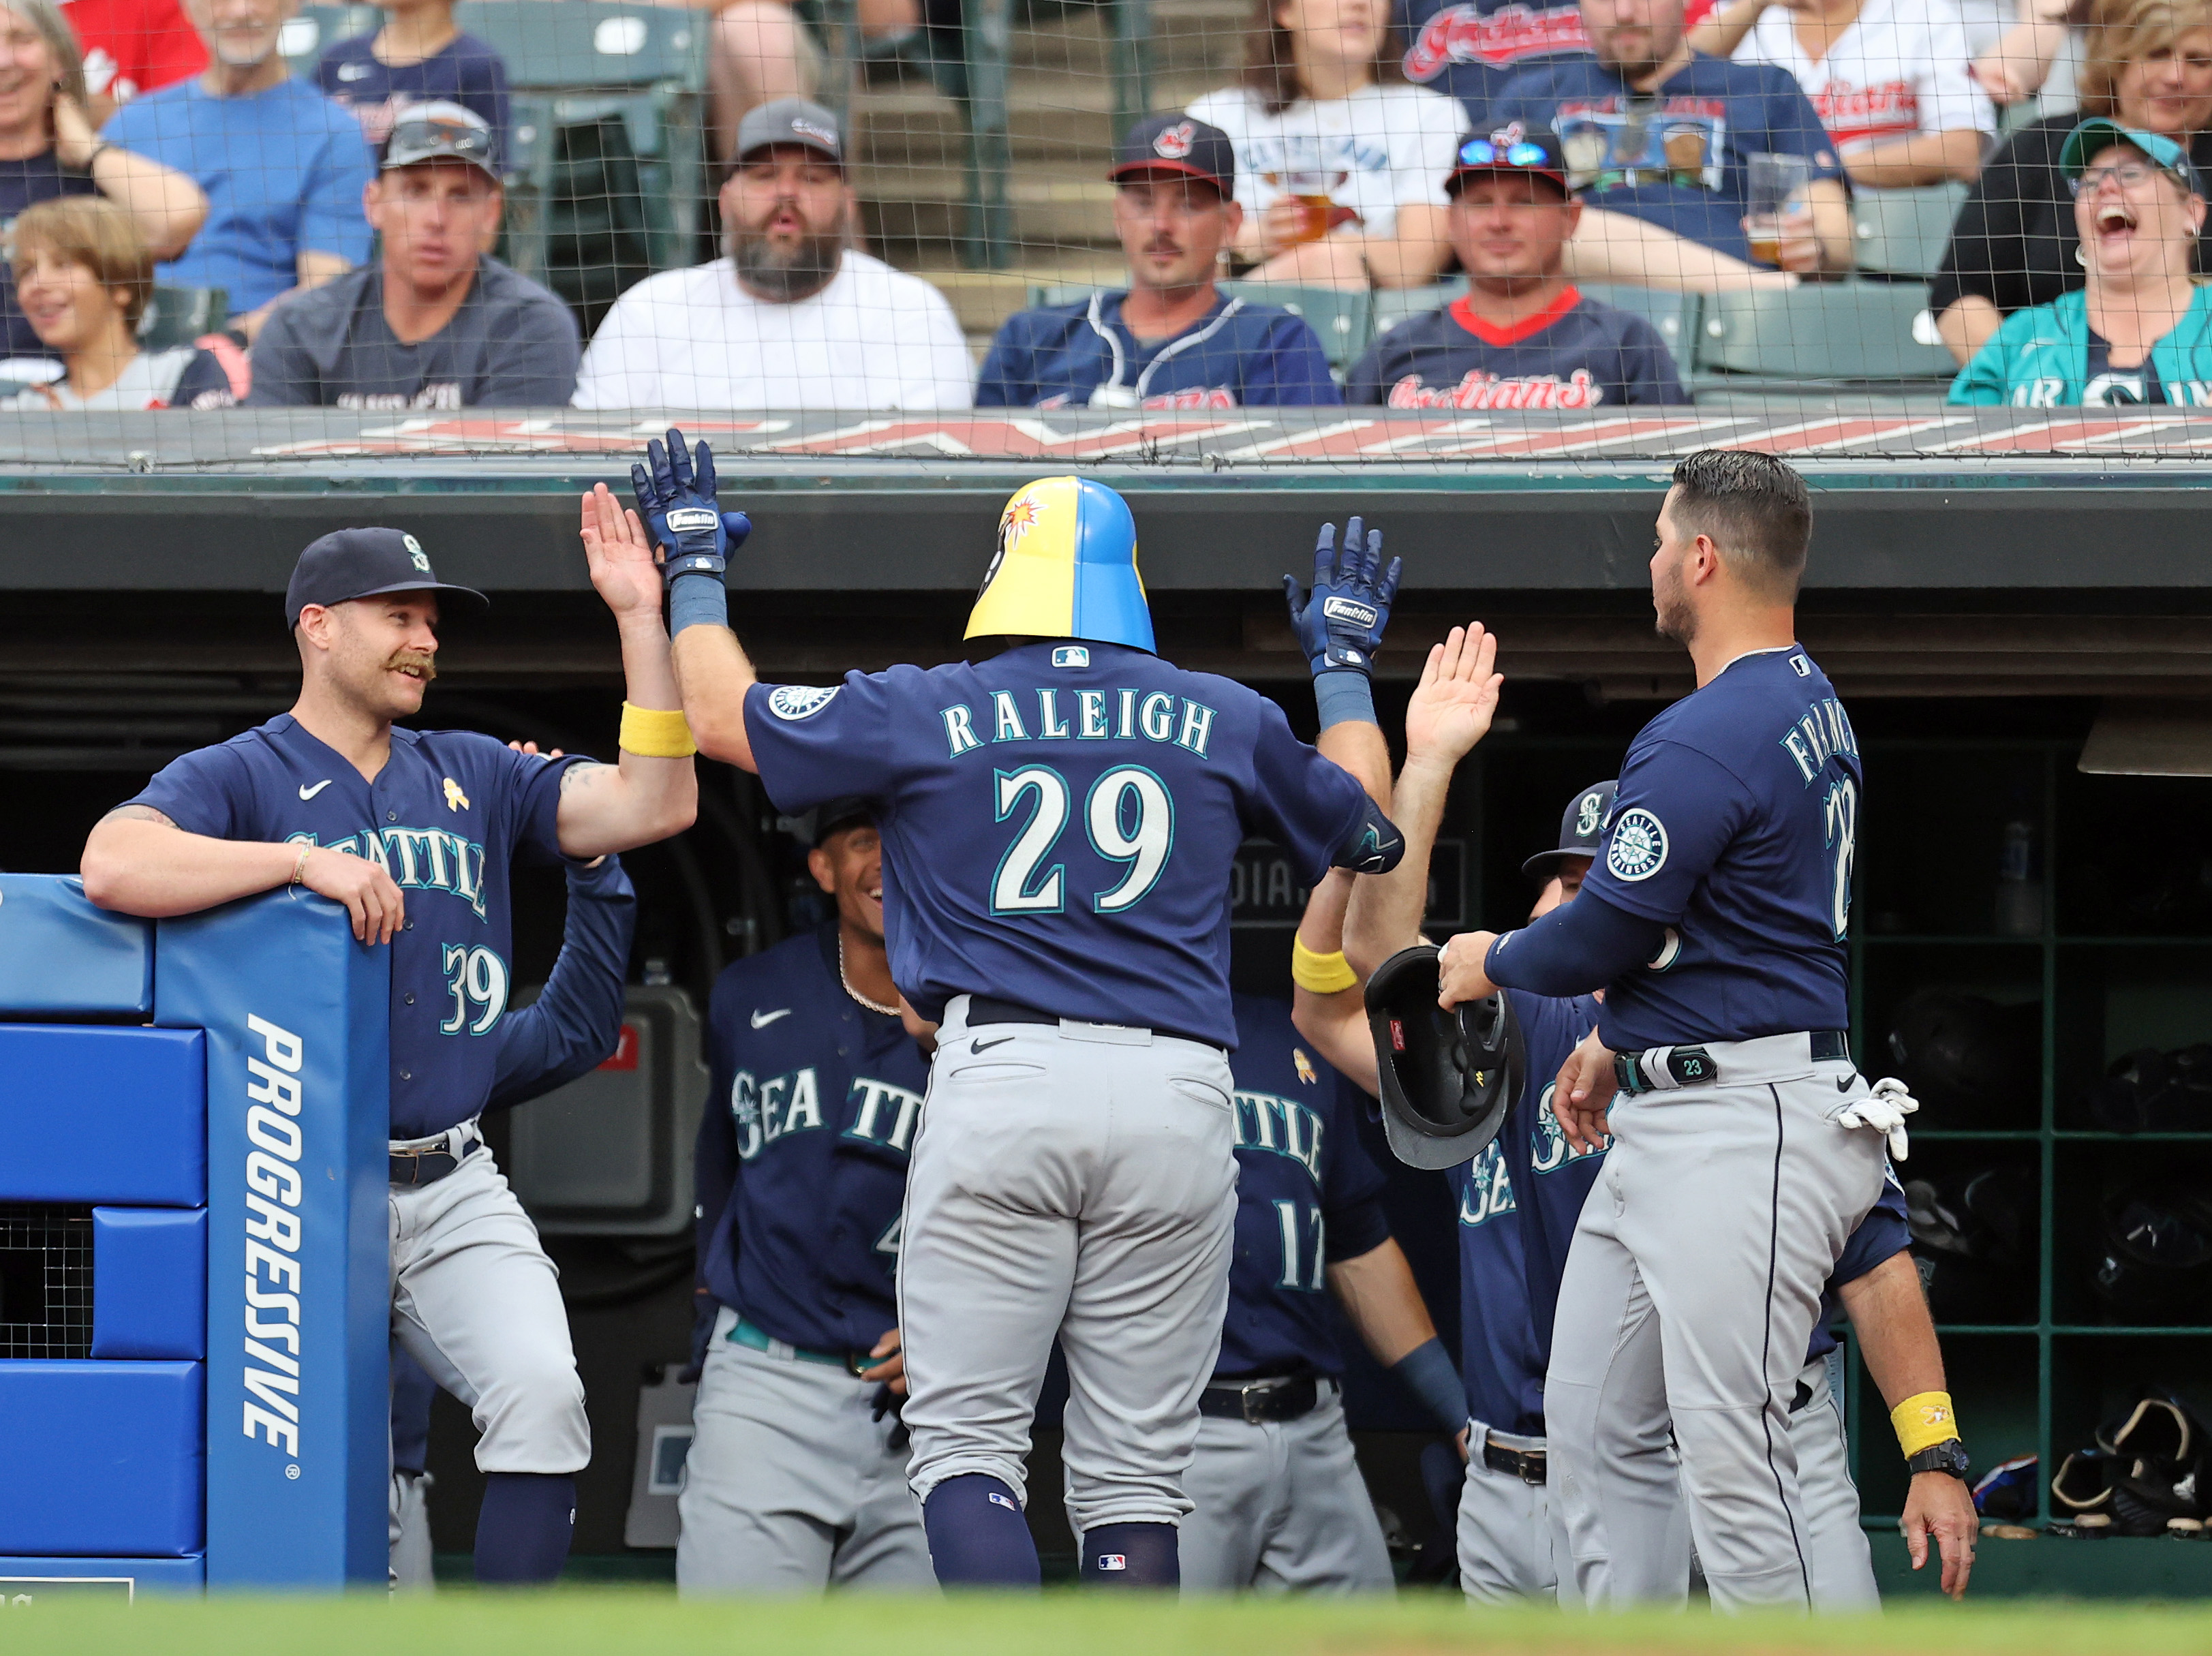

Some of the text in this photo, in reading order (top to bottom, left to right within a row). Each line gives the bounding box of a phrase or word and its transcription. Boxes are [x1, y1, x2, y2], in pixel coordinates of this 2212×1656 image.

[671, 512, 715, 528] Franklin
[1327, 600, 1374, 623] Franklin
[940, 688, 1217, 759] RALEIGH
[1779, 699, 1859, 789] FRANC
[1576, 793, 1603, 837] S
[1620, 816, 1661, 846] SEATTLE
[989, 764, 1175, 917] 29
[1612, 844, 1655, 874] MARINERS
[440, 942, 508, 1036] 39
[1683, 1059, 1702, 1077] 23
